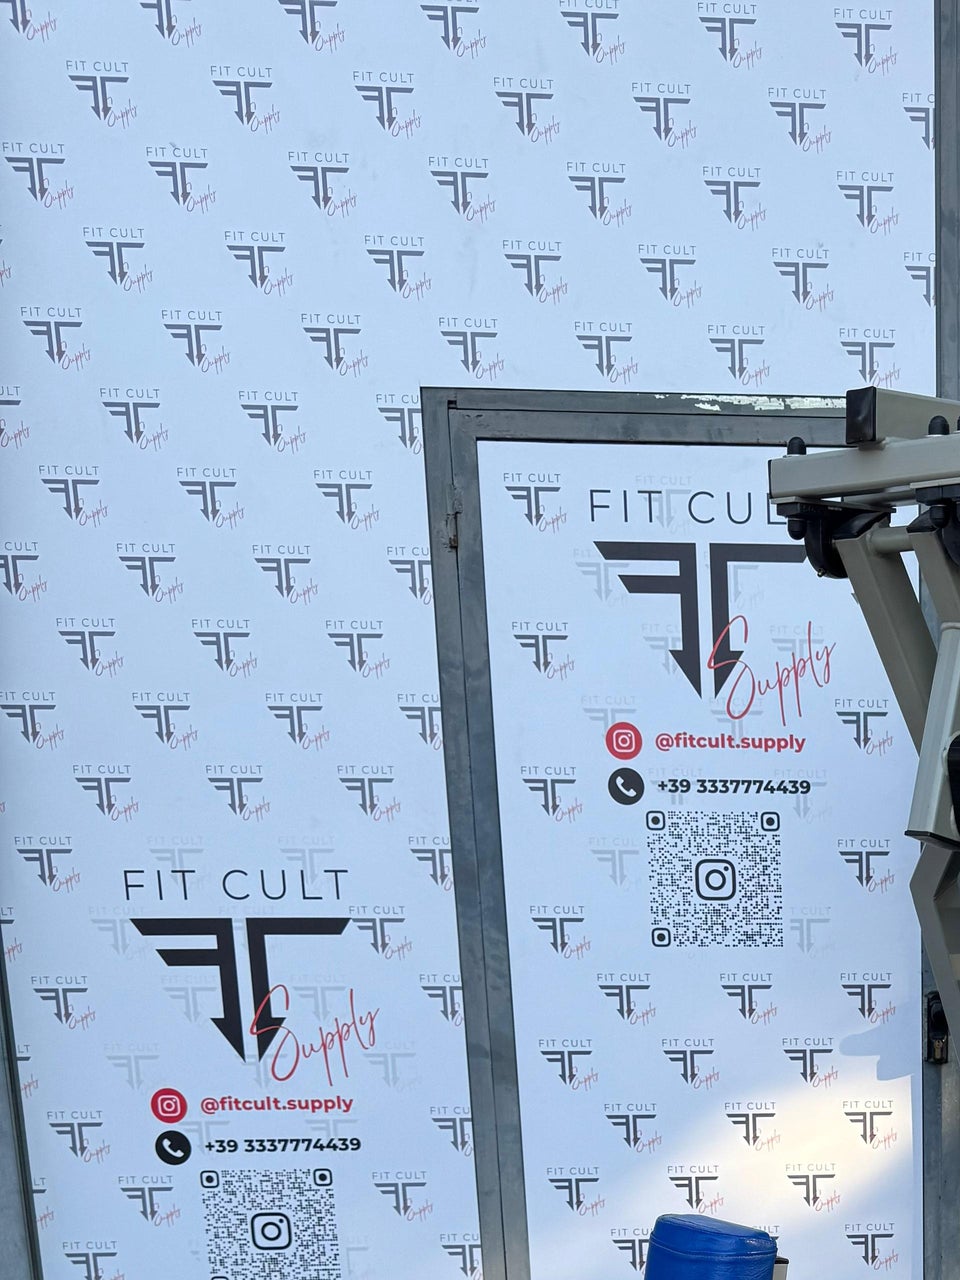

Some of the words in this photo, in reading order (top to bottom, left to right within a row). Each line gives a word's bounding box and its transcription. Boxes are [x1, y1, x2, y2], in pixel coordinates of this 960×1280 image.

[65, 60, 87, 73] FIT
[92, 60, 129, 73] CULT
[631, 82, 652, 95] FIT
[657, 82, 692, 95] CULT
[287, 151, 309, 164] FIT
[314, 151, 350, 164] CULT
[224, 230, 245, 243] FIT
[250, 230, 286, 243] CULT
[637, 243, 658, 256] FIT
[663, 243, 697, 256] CULT
[313, 469, 333, 481] FIT
[338, 469, 373, 481] CULT
[503, 472, 523, 484] FIT
[527, 472, 561, 484] CULT
[589, 489, 662, 523] FIT
[687, 491, 788, 526] CUL
[191, 618, 211, 629] FIT
[216, 618, 250, 629] CULT
[707, 614, 837, 727] Supply
[655, 732, 806, 753] @fitcult.supply
[336, 765, 356, 775] FIT
[361, 765, 394, 775] CULT
[657, 779, 691, 795] +39
[696, 779, 811, 795] 3337774439
[123, 869, 196, 901] FIT
[222, 869, 349, 901] CULT
[596, 973, 615, 982] FIT
[619, 973, 651, 982] CULT
[249, 984, 380, 1087] Supply
[782, 1037, 799, 1046] FIT
[804, 1037, 833, 1046] CULT
[200, 1095, 354, 1115] @fitcult.supply
[46, 1110, 65, 1120] FIT
[70, 1110, 102, 1120] CULT
[205, 1139, 239, 1153] +39
[244, 1137, 361, 1153] 3337774439
